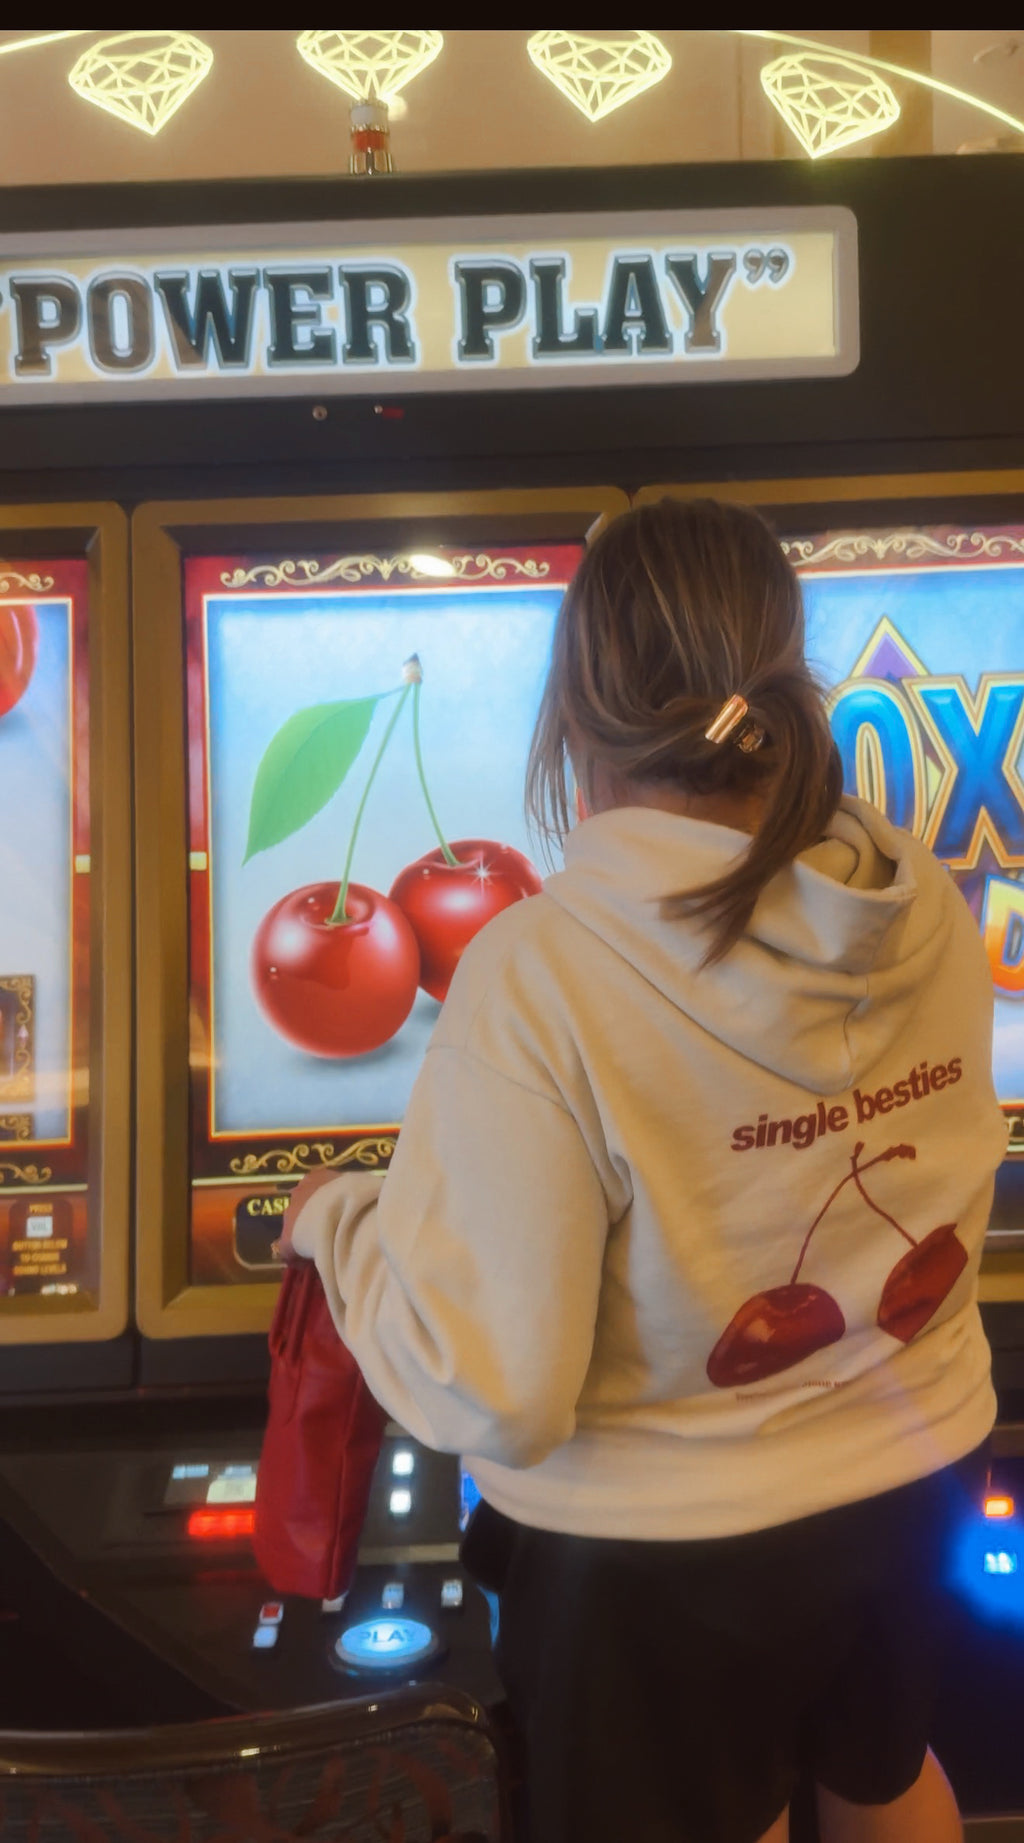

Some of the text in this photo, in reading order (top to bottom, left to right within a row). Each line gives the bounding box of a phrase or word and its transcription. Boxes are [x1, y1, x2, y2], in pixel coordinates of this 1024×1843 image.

[730, 1057, 963, 1151] single besties
[359, 1629, 416, 1643] PLAY
